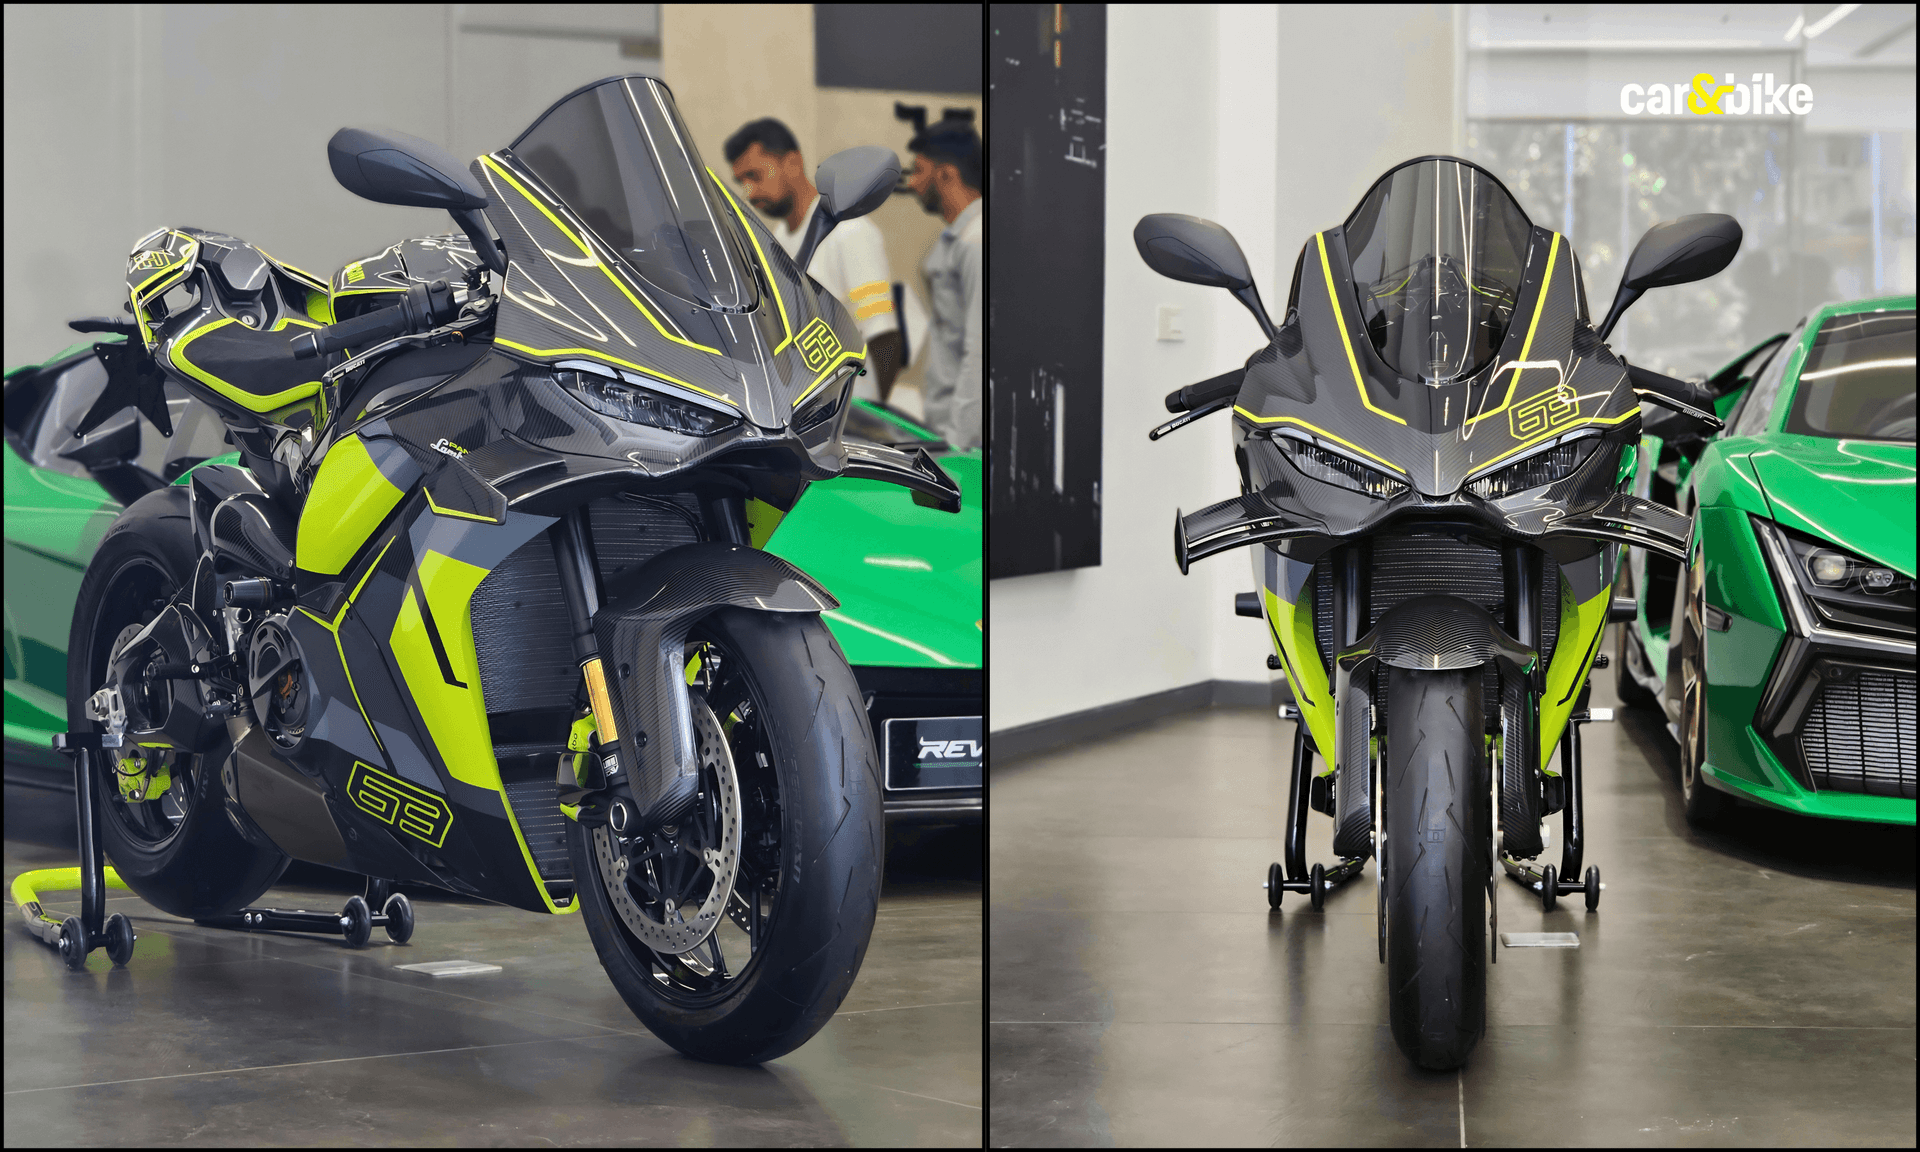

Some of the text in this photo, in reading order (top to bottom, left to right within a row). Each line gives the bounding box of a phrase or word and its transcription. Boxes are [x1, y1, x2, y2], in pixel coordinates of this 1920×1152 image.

[794, 316, 842, 373] 63
[1508, 384, 1580, 441] 63
[346, 760, 454, 849] 63
